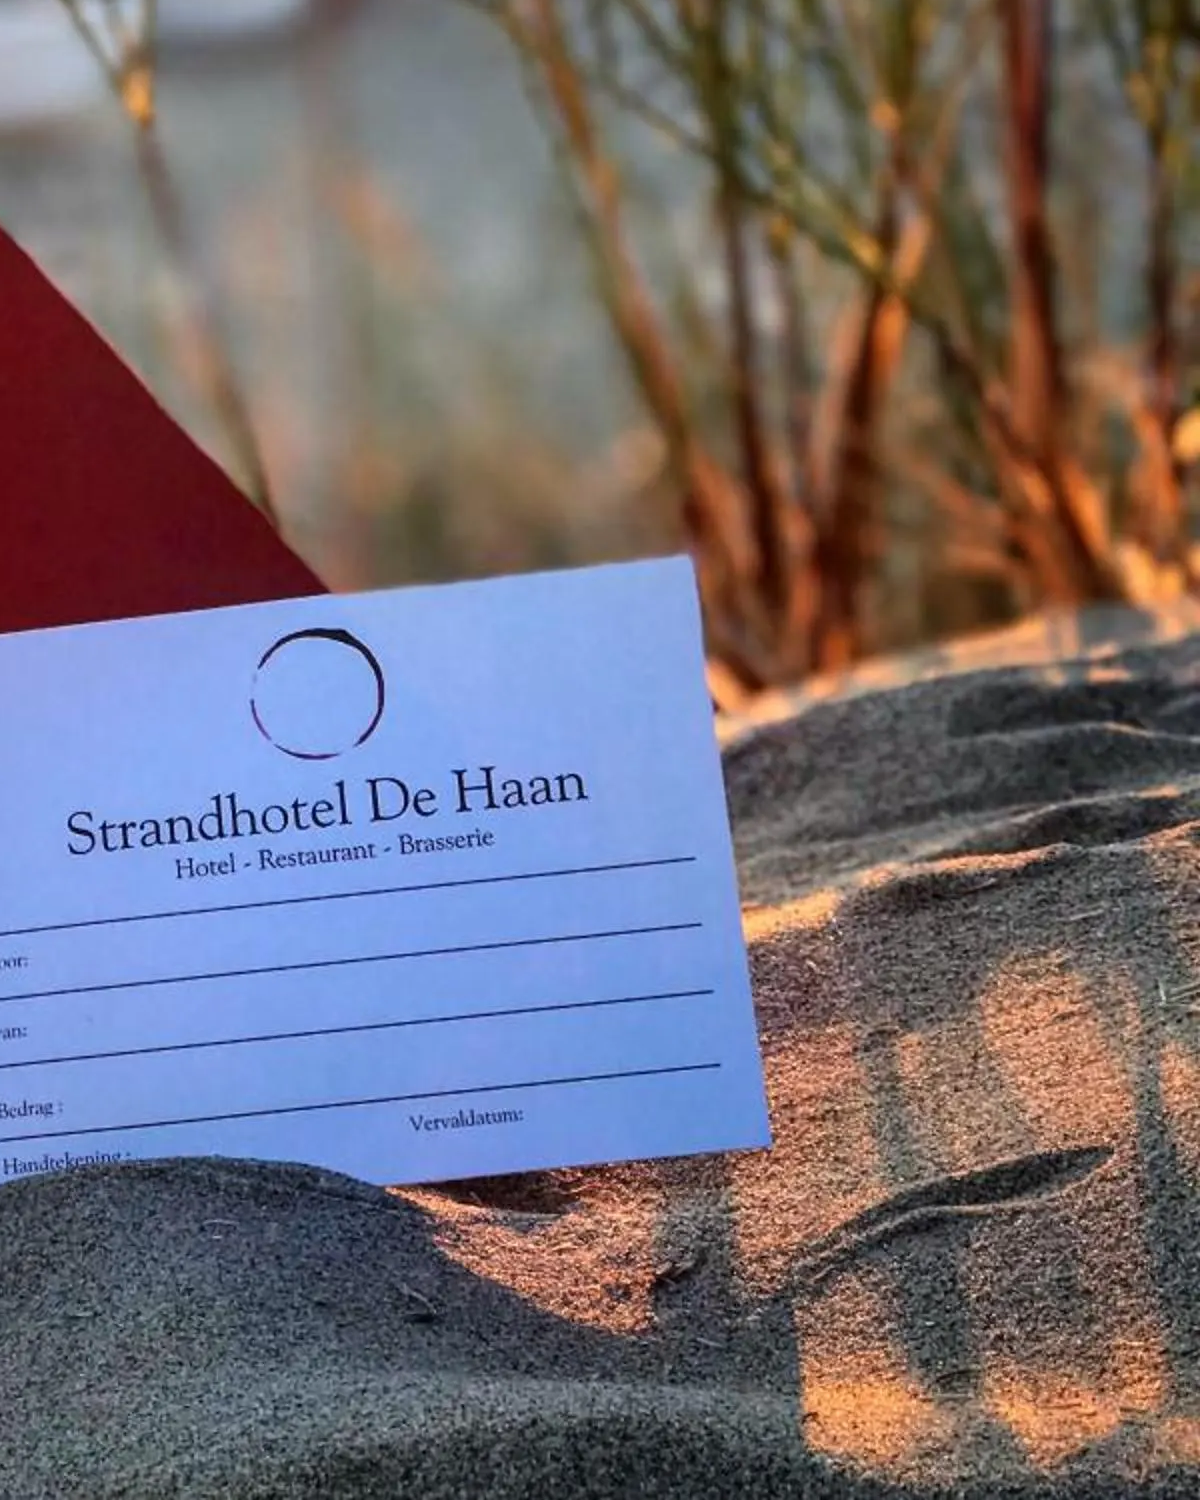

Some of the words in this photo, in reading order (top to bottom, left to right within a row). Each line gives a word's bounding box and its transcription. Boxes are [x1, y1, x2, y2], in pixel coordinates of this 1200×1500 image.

[66, 781, 351, 855] Strandhotel
[367, 776, 437, 823] De
[451, 765, 588, 813] Haan
[175, 854, 236, 879] Hotel
[258, 842, 376, 871] Restaurant
[399, 828, 495, 856] Brasserie
[409, 1108, 525, 1132] Vervaldatum:
